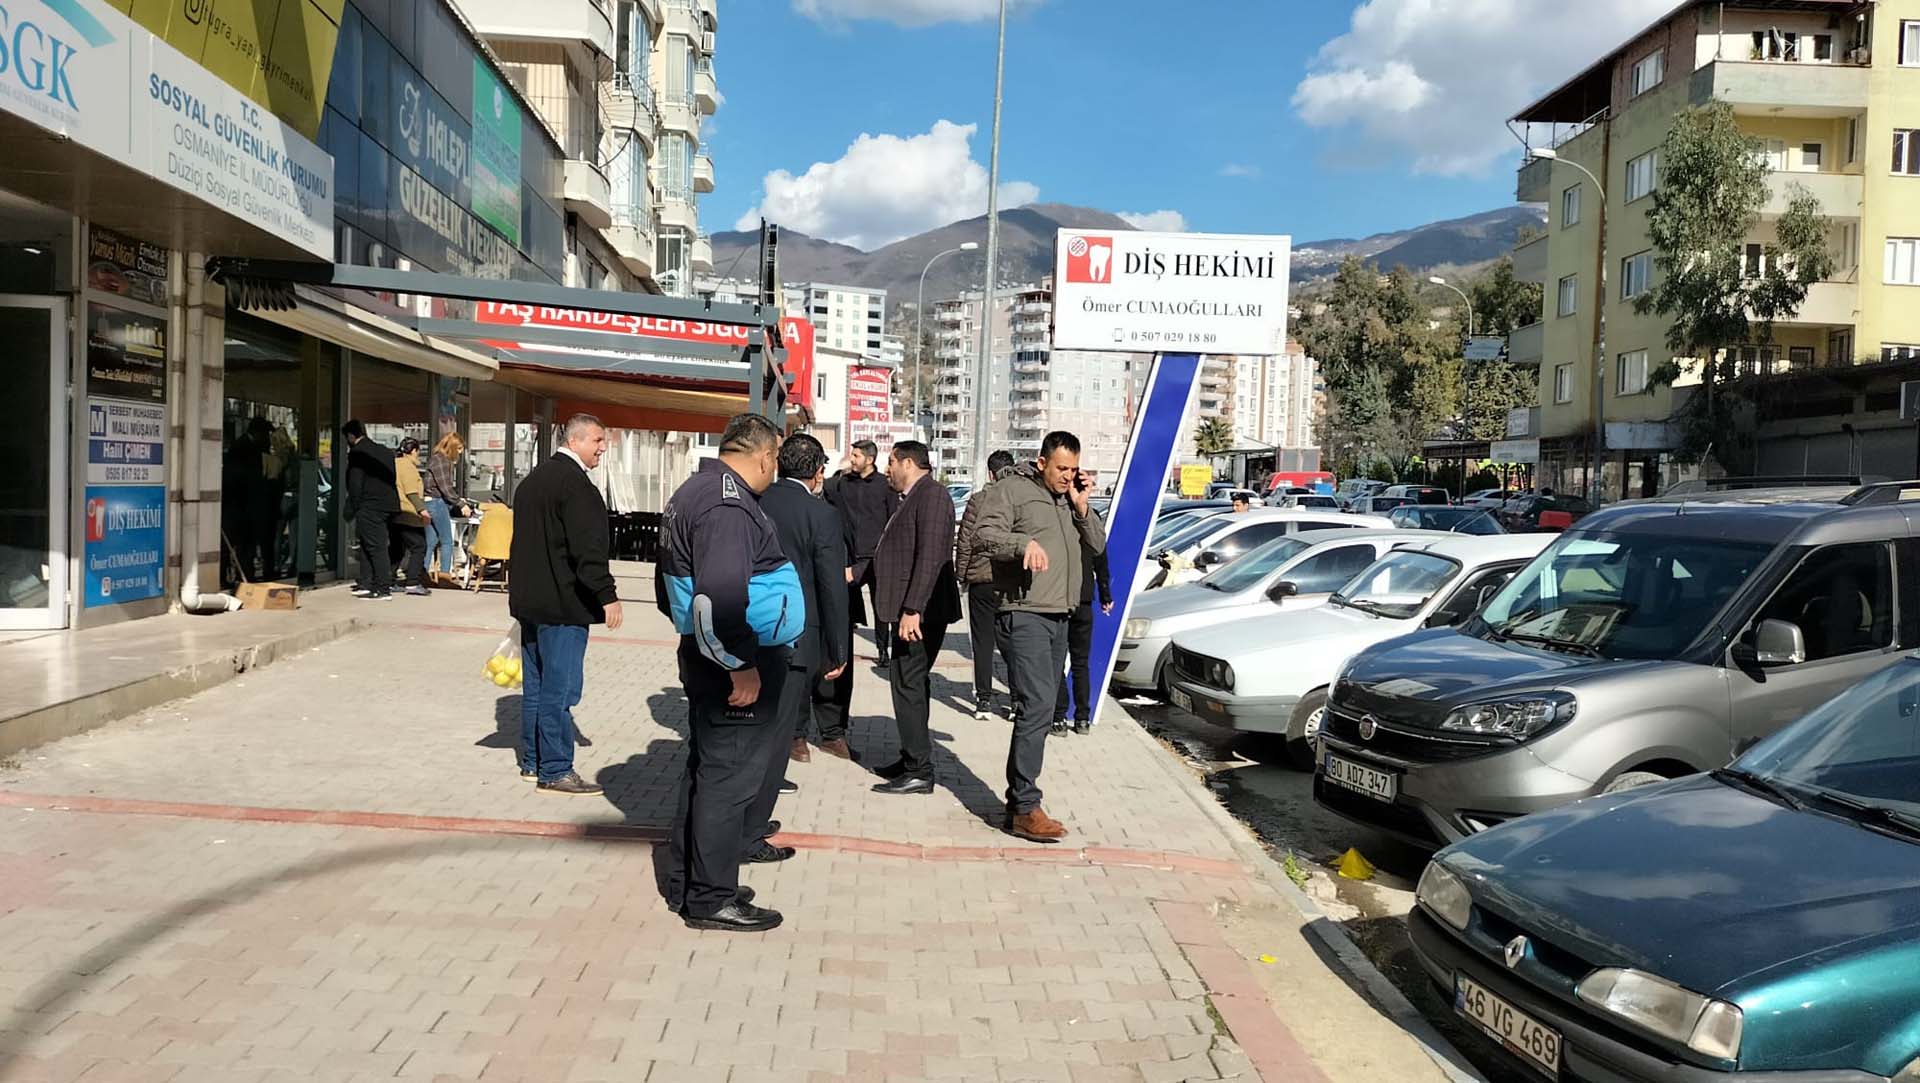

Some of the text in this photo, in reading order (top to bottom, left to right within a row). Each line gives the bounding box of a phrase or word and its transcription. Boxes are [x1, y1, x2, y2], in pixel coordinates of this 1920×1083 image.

[240, 101, 262, 131] T.C.
[150, 73, 327, 199] SOSYAL GÜVENLİK KURUMU
[174, 124, 239, 177] OSMANİYE
[168, 152, 315, 244] Düziçi Sosyal Güvenlik Merkezi
[400, 163, 463, 249] GÜZELLİK
[1124, 247, 1276, 281] DİŞ HEKİMİ
[1082, 296, 1263, 318] Ömer CUMAOĞULLARI
[1131, 332, 1217, 344] 0 507 029 18 80
[91, 411, 105, 433] M
[108, 503, 161, 535] DİŞ HEKİMİ
[1331, 758, 1343, 778] 80
[1347, 764, 1364, 787] ADZ
[1368, 771, 1388, 793] 347
[1465, 985, 1486, 1018] 46
[1492, 999, 1513, 1036] VG
[1520, 1020, 1556, 1064] 469
